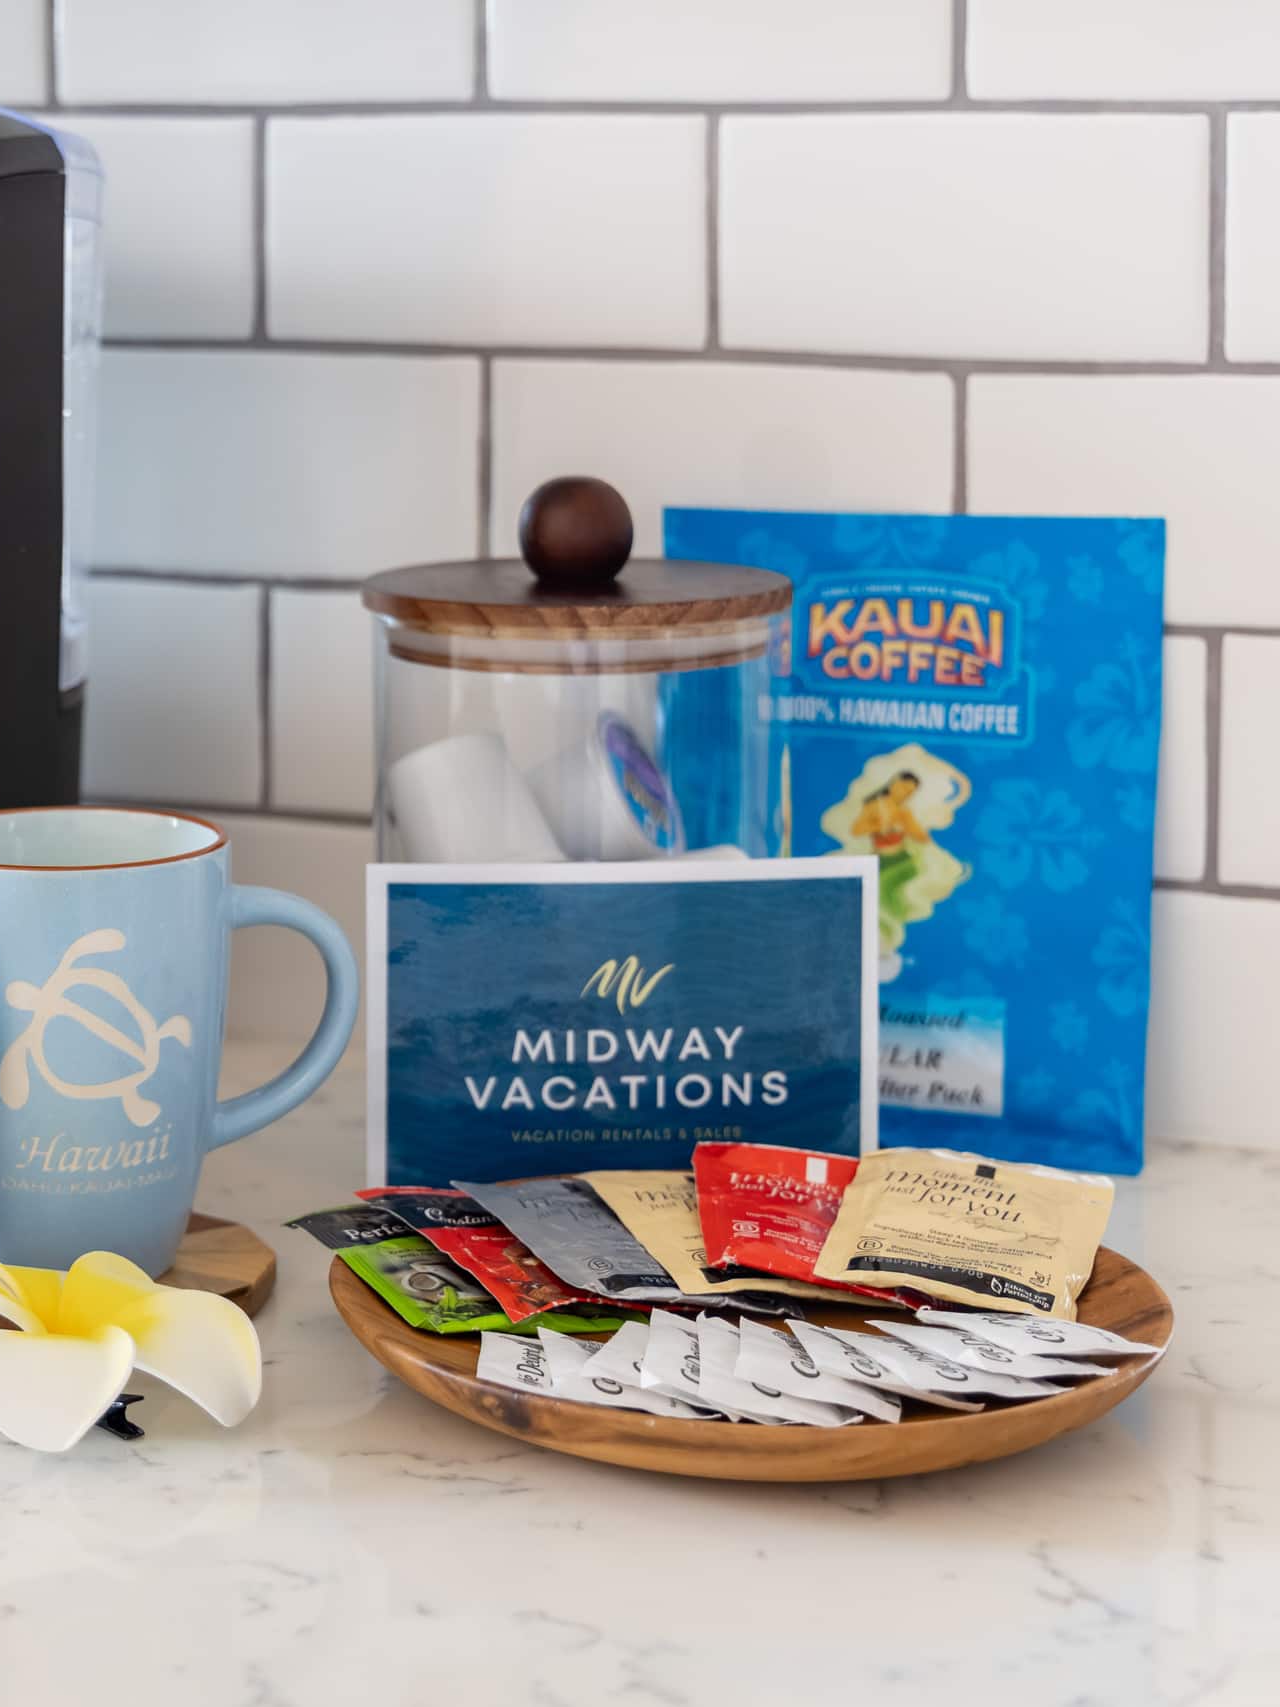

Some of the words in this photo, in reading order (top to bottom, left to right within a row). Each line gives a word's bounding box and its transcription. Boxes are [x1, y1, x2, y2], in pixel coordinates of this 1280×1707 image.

[807, 597, 1004, 668] KAUAI
[822, 640, 986, 687] COFFEE
[839, 698, 945, 731] HAWAIIAN
[948, 703, 1019, 736] COFFEE
[511, 1025, 744, 1064] MIDWAY
[464, 1070, 789, 1111] VACATIONS
[15, 1122, 174, 1173] Hawaii
[511, 1129, 596, 1144] VACATION
[602, 1127, 672, 1143] RENTALS
[693, 1125, 743, 1140] SALES
